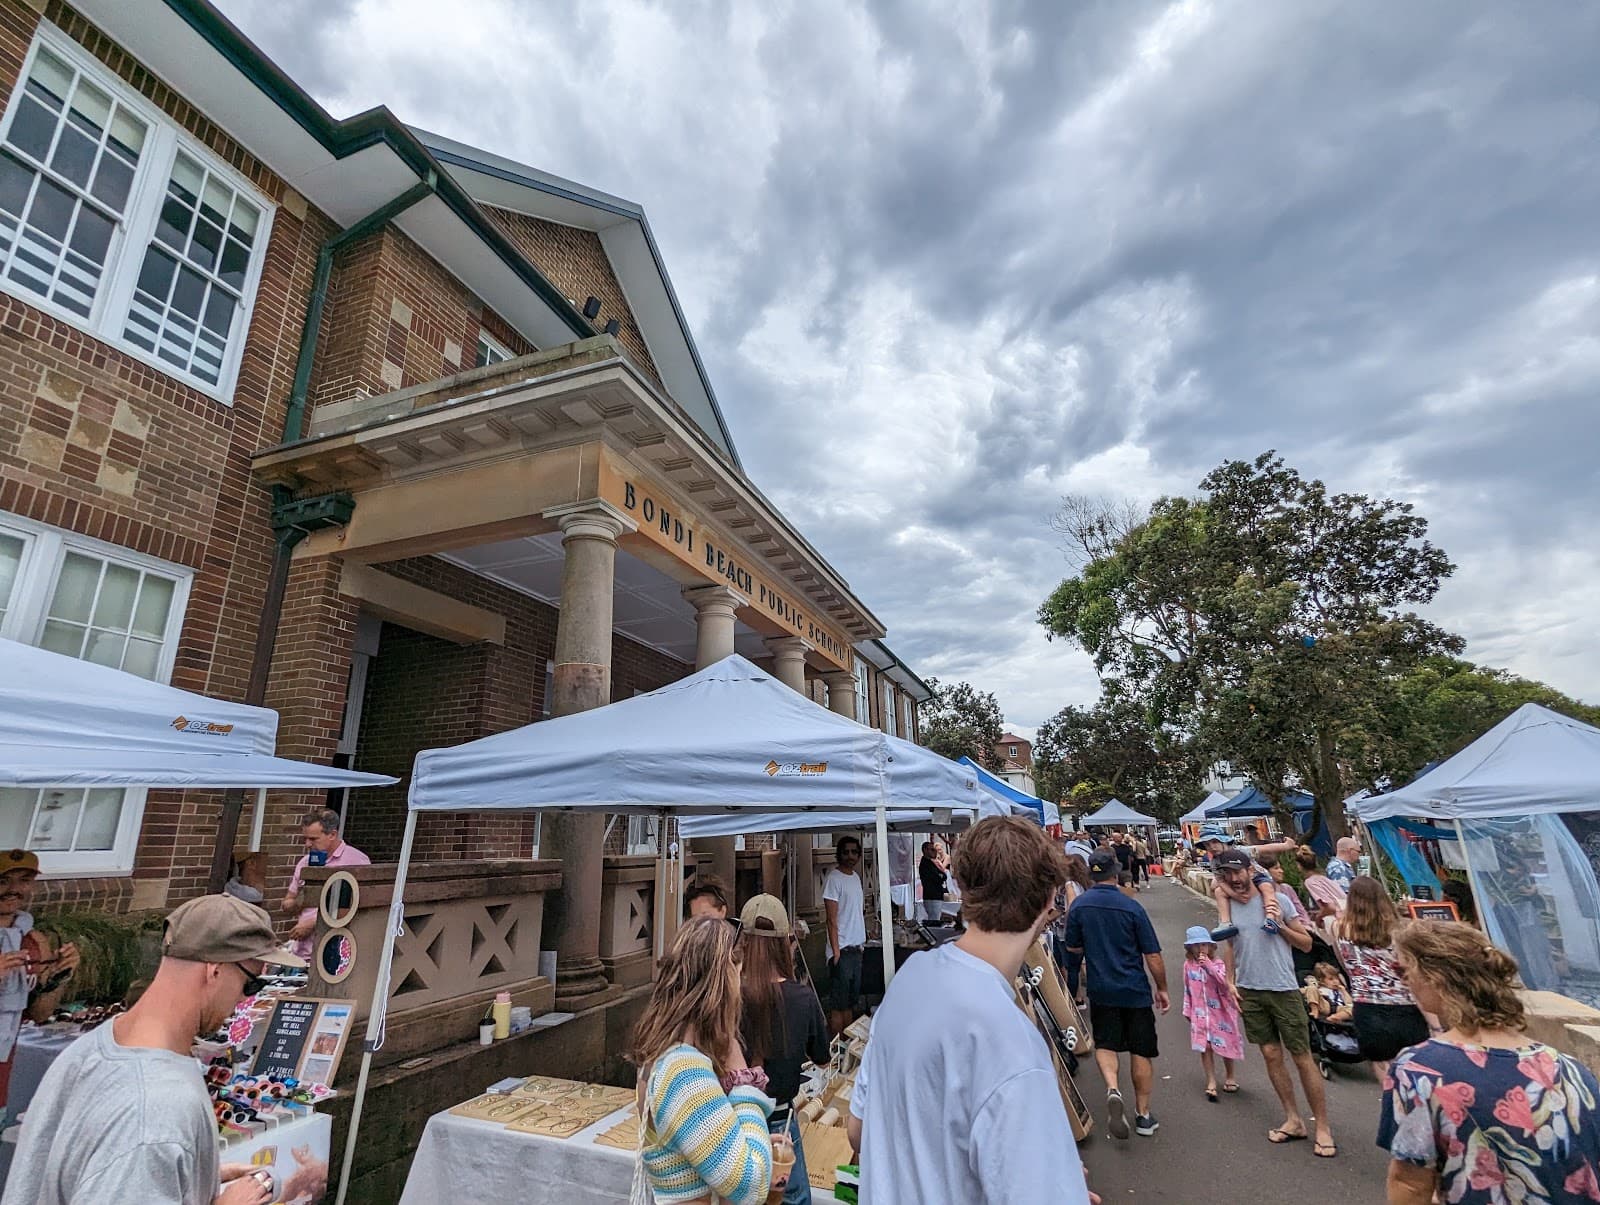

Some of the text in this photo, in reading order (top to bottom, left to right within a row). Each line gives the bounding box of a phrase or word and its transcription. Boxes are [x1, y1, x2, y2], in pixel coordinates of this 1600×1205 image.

[624, 481, 846, 662] BONDI BEACH PUBLIC SCHOOL
